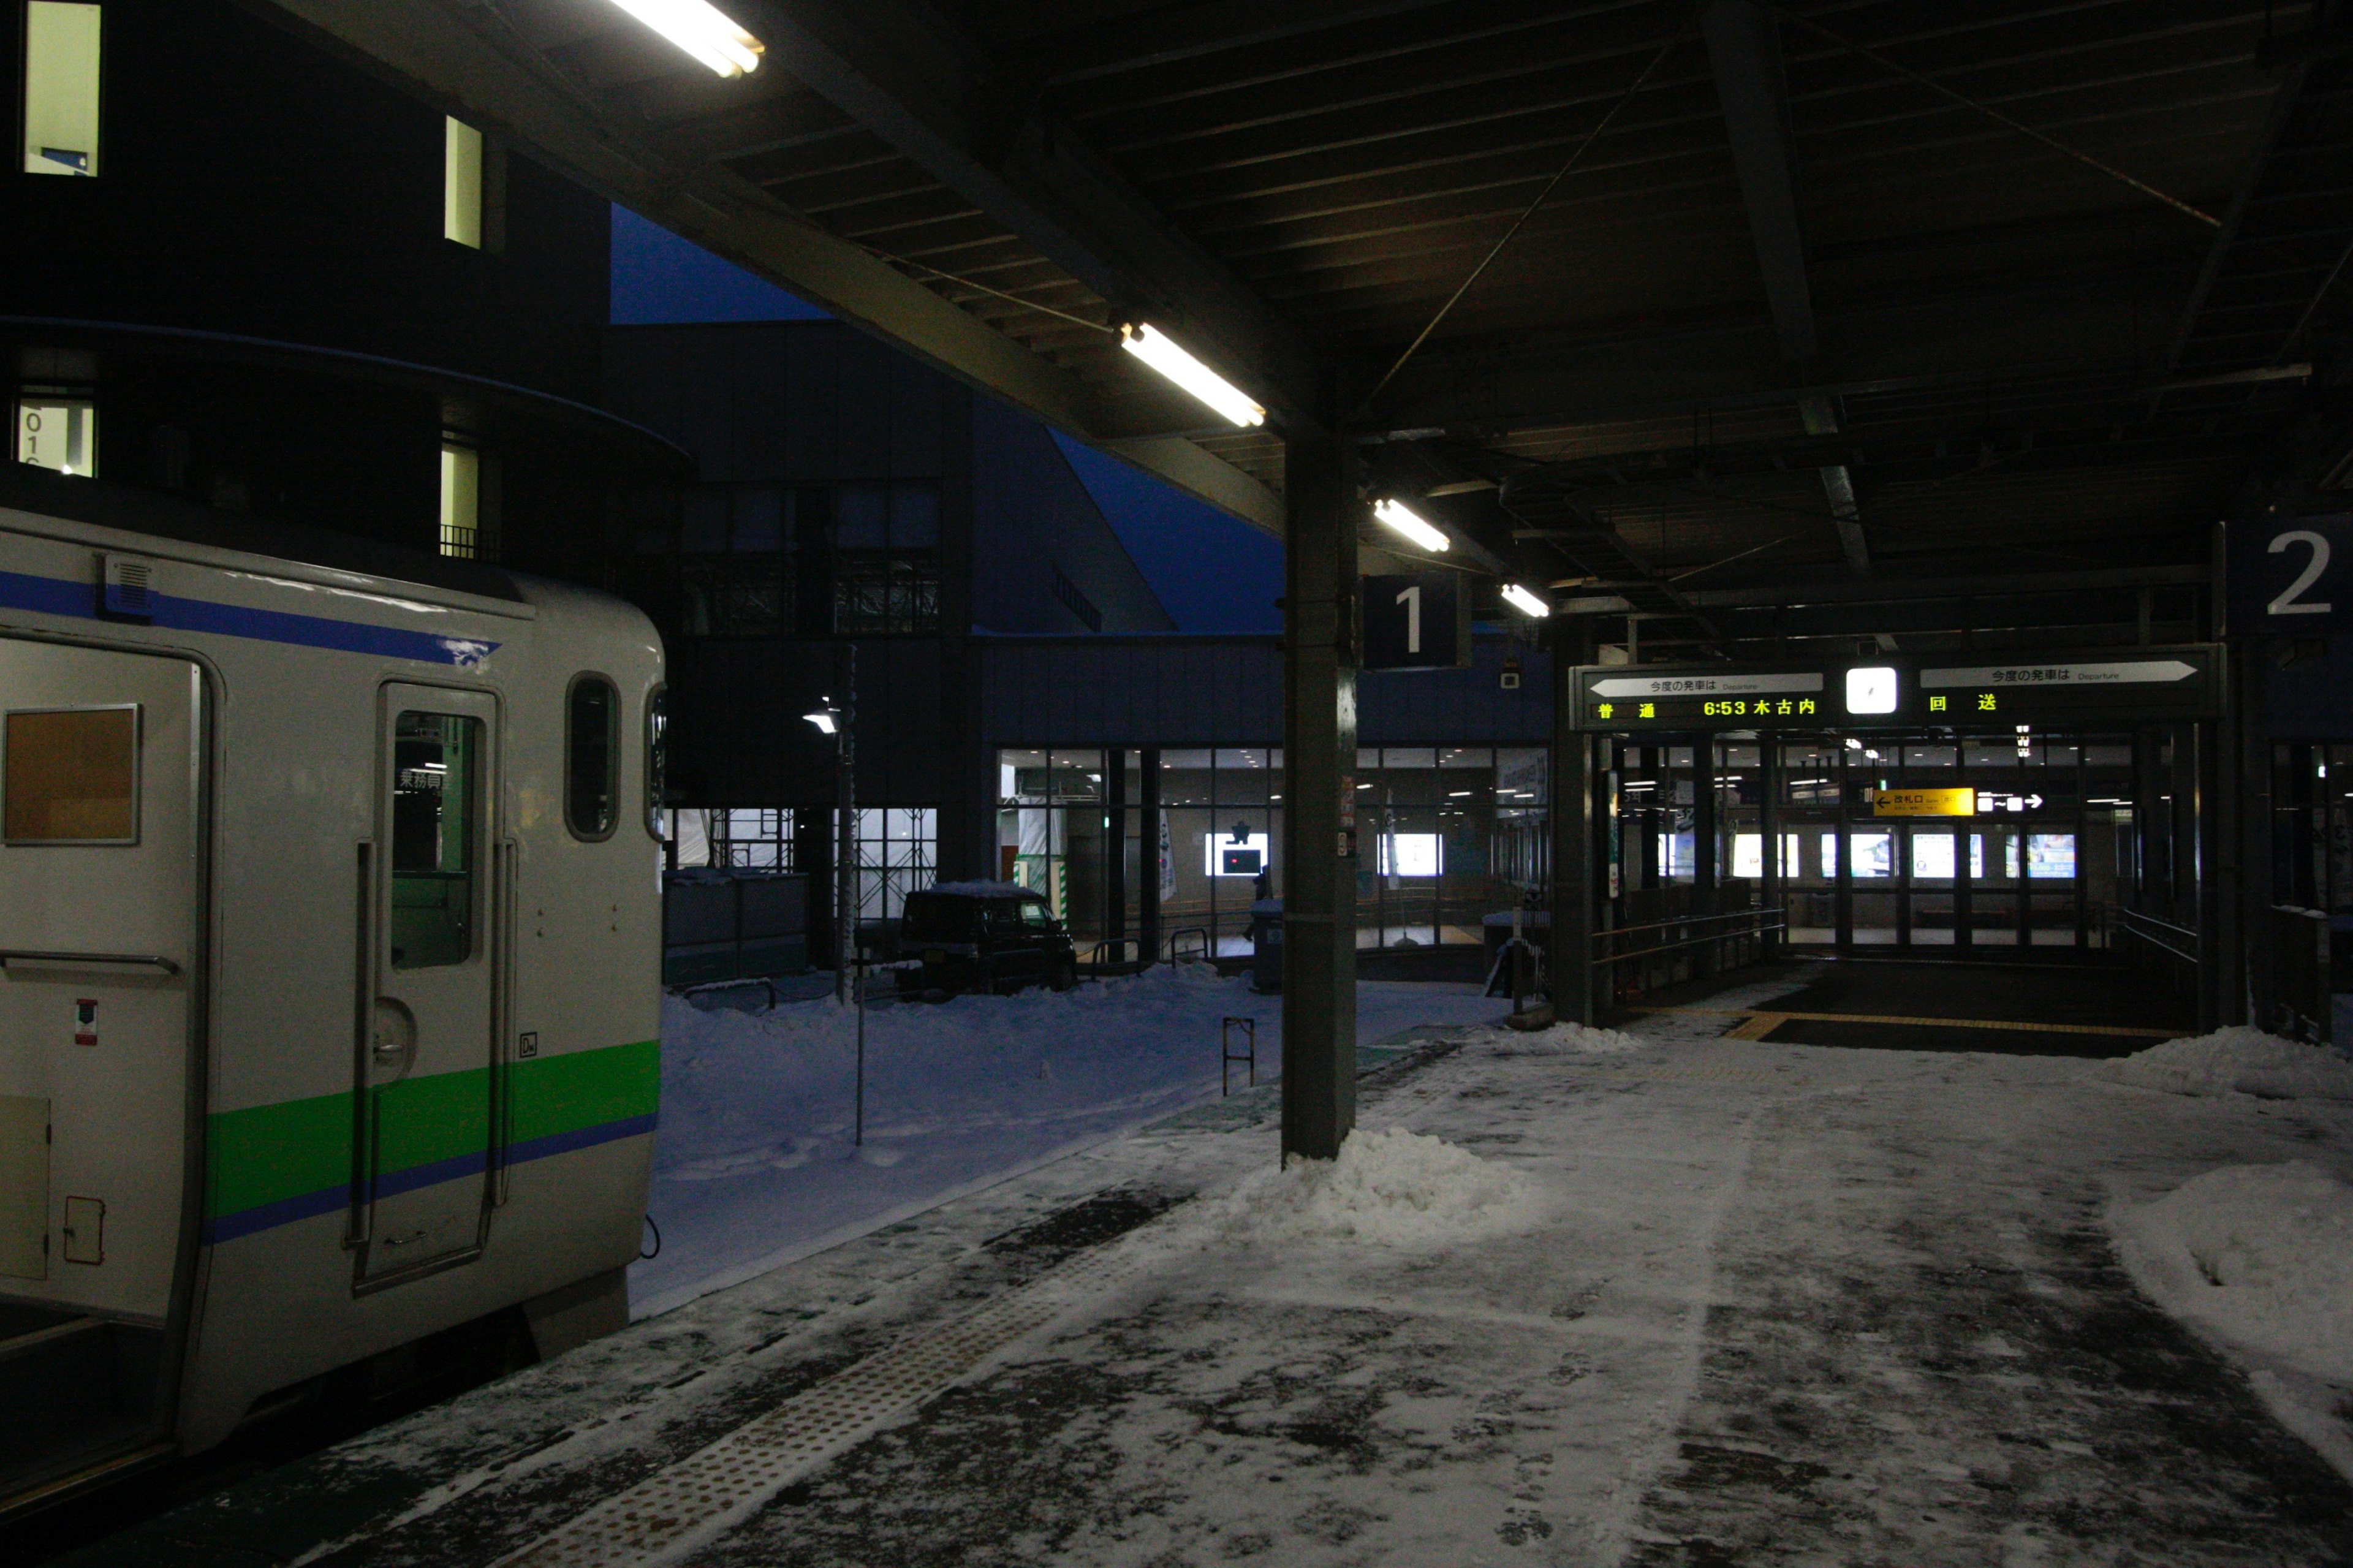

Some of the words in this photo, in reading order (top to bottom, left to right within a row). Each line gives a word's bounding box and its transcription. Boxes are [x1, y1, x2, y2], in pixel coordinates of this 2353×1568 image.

[2267, 530, 2332, 615] 2
[1396, 586, 1420, 653] 1
[1993, 668, 2069, 681] 今度の発車は
[2078, 672, 2119, 681] Departure
[1651, 680, 1716, 692] 今度の発車は
[1703, 701, 1746, 716] 6:53
[1753, 698, 1815, 716] 木古内
[1894, 794, 1923, 803] 改札口
